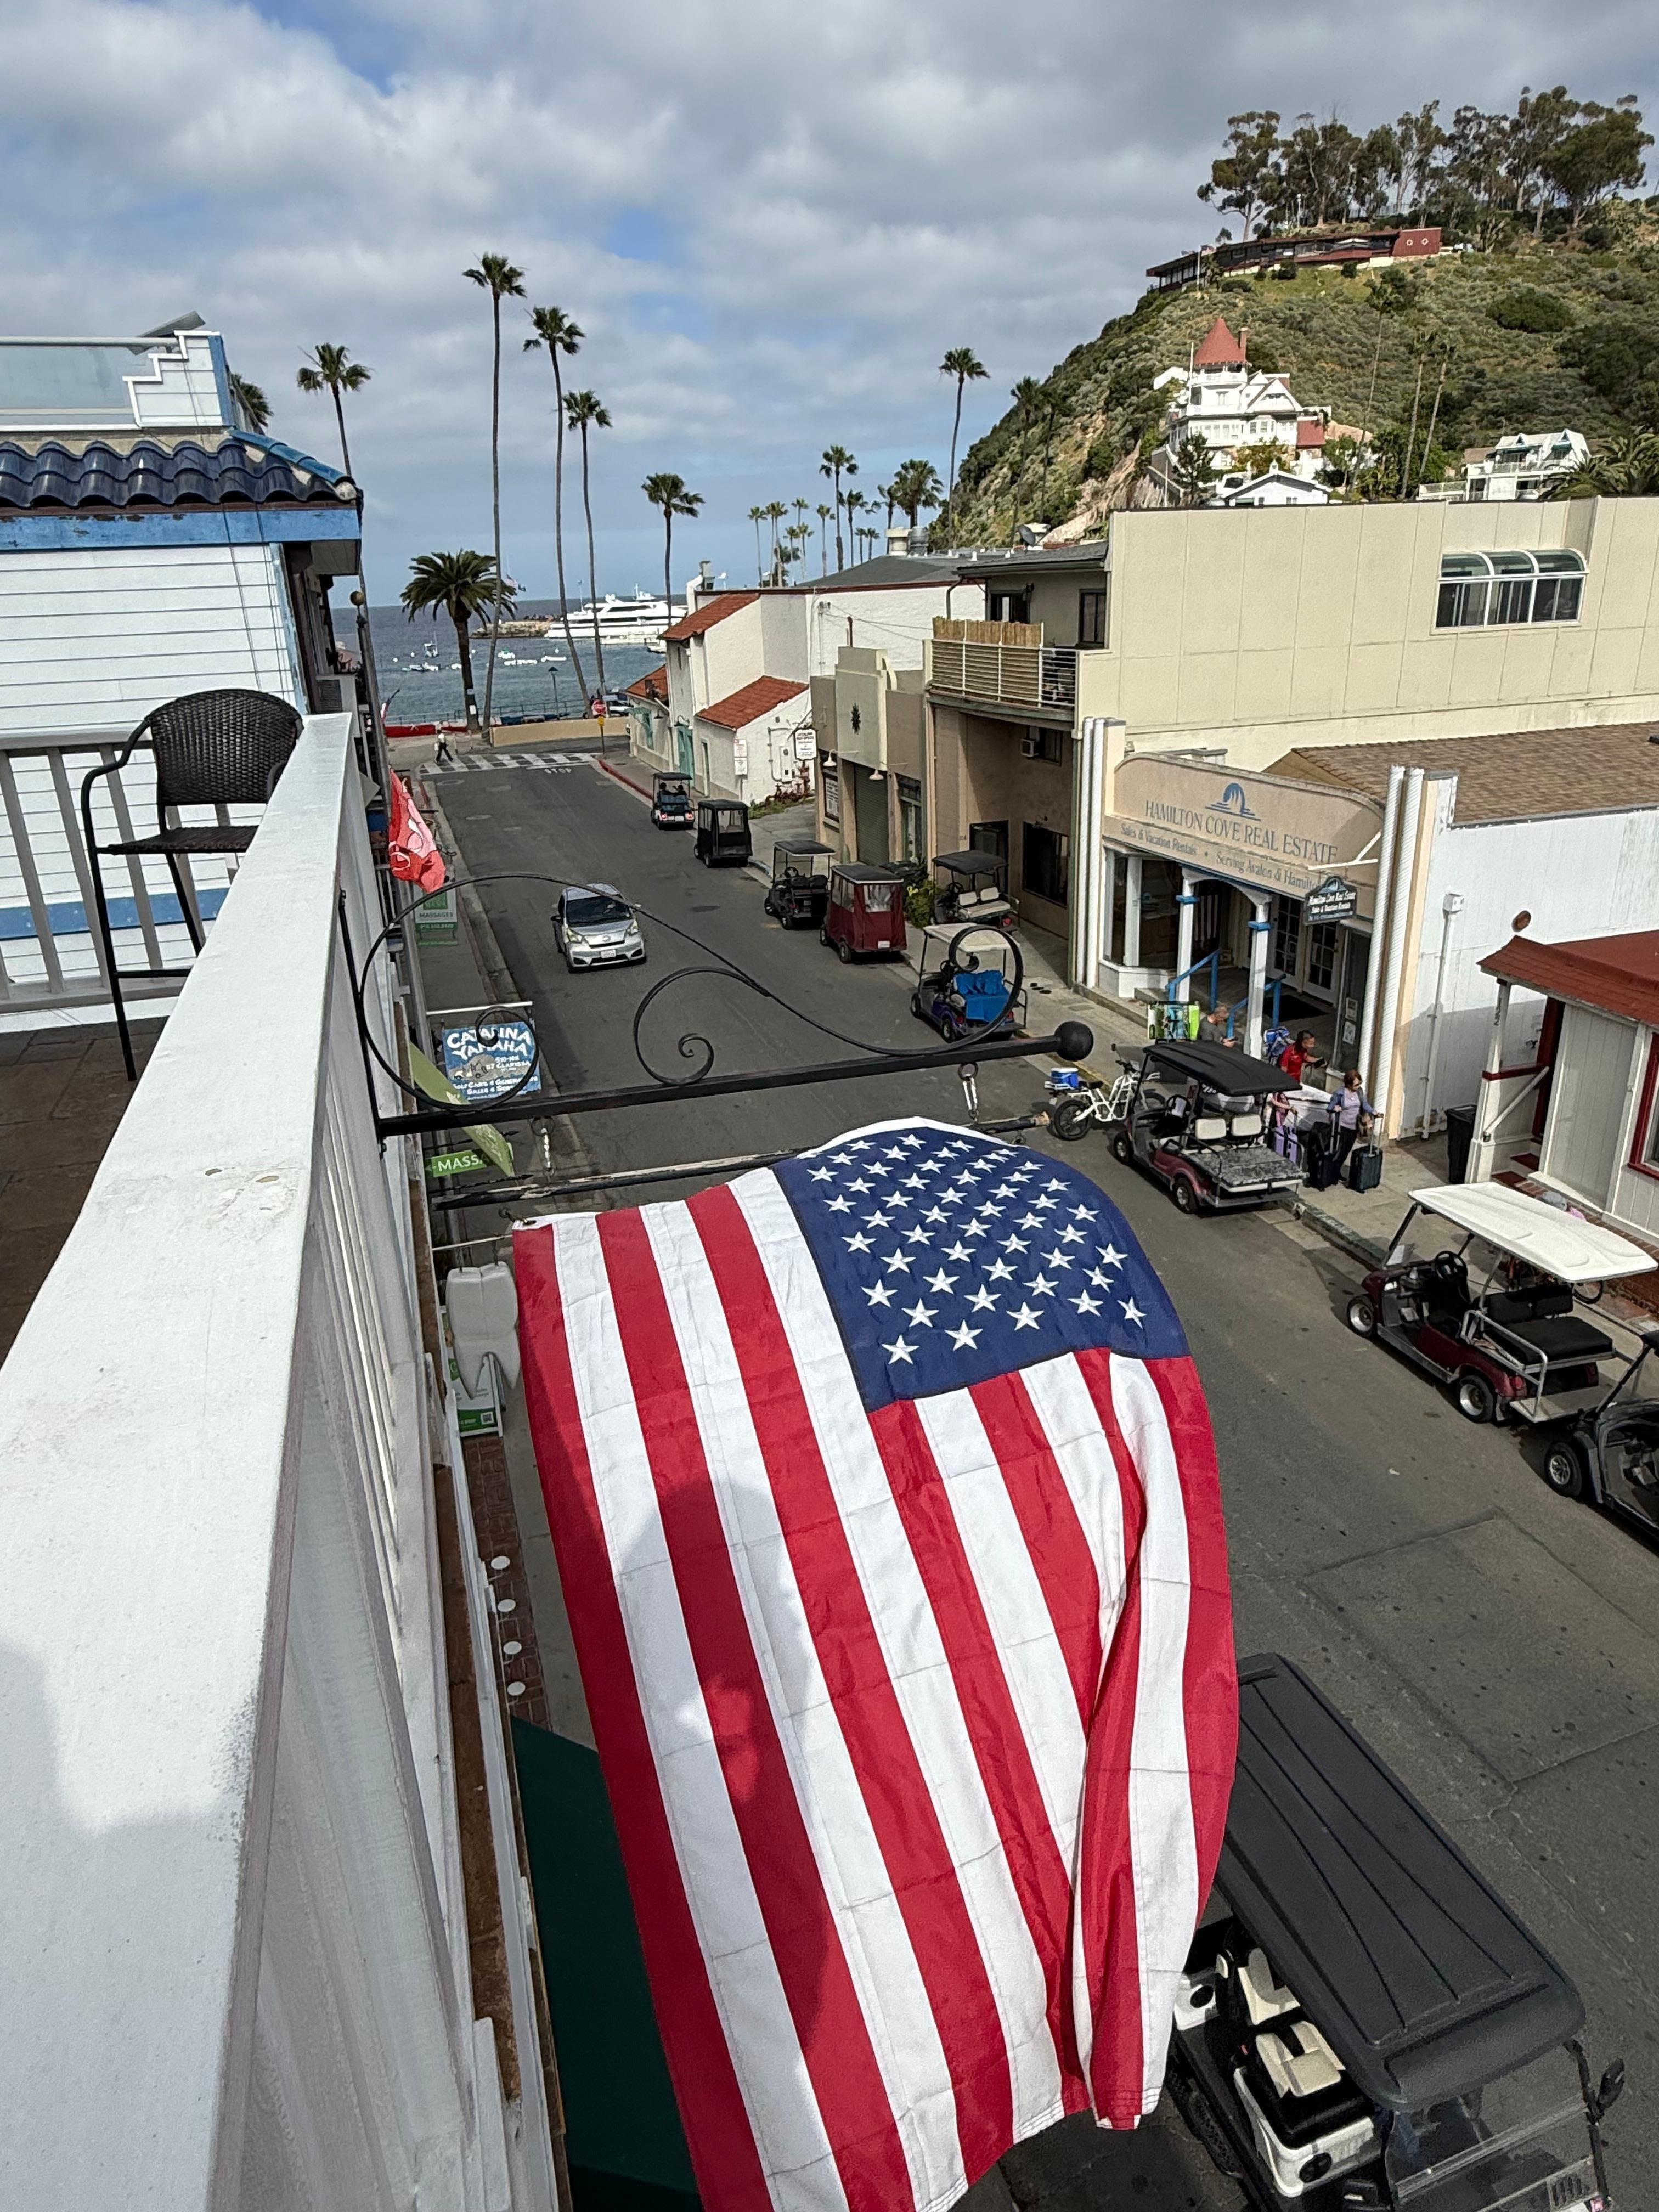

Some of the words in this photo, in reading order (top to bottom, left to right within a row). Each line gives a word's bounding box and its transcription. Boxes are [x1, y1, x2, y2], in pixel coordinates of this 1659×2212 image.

[1120, 823, 1137, 838] Sales
[1138, 828, 1144, 840] &
[1145, 830, 1171, 848] Vacation
[1172, 838, 1197, 856] Rentals
[1216, 851, 1244, 873] Serving
[1246, 860, 1273, 878] Avalon
[1274, 868, 1282, 881] &
[1284, 870, 1318, 891] Hamilto
[1146, 800, 1204, 831] HAMILTON
[1206, 815, 1242, 842] COVE
[1244, 825, 1278, 851] REAL
[1283, 834, 1339, 865] ESTATE
[438, 1154, 483, 1172] MASS
